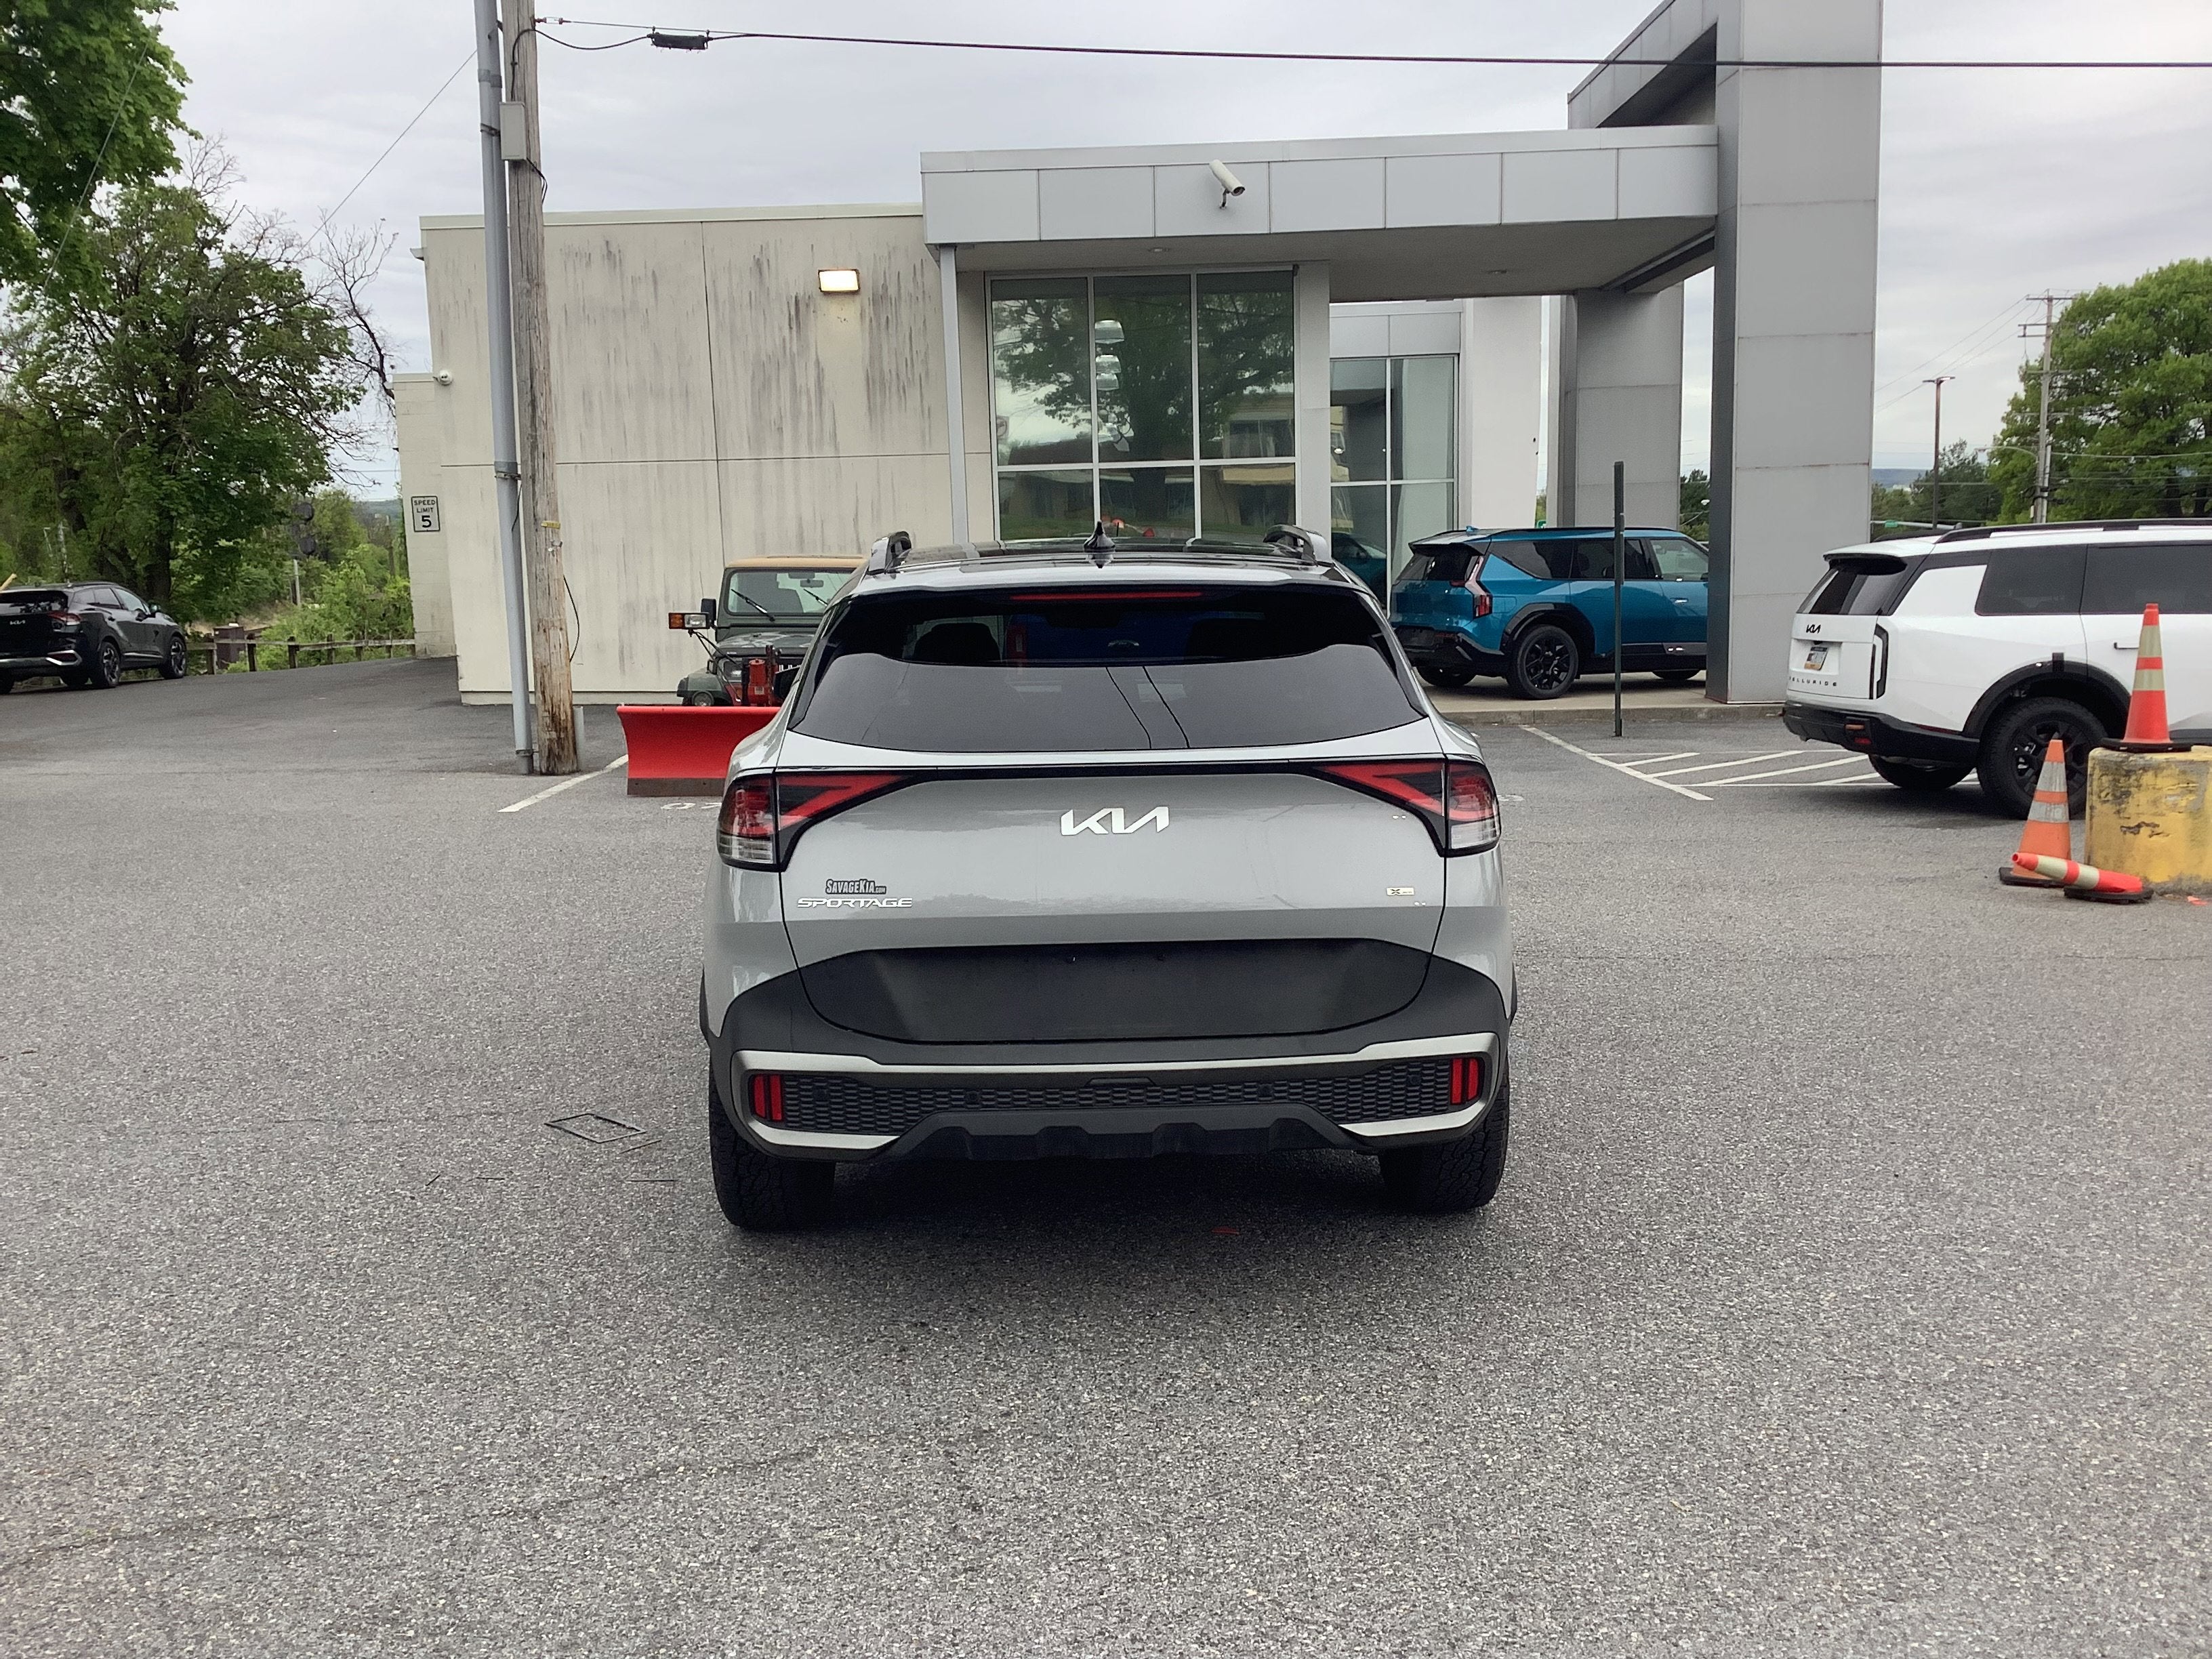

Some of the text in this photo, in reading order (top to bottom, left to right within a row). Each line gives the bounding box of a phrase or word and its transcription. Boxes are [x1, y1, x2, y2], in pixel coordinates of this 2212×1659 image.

[422, 515, 432, 528] 5
[1806, 624, 1822, 634] KIA
[1061, 806, 1170, 836] KIA
[797, 897, 913, 908] SPORTAGE
